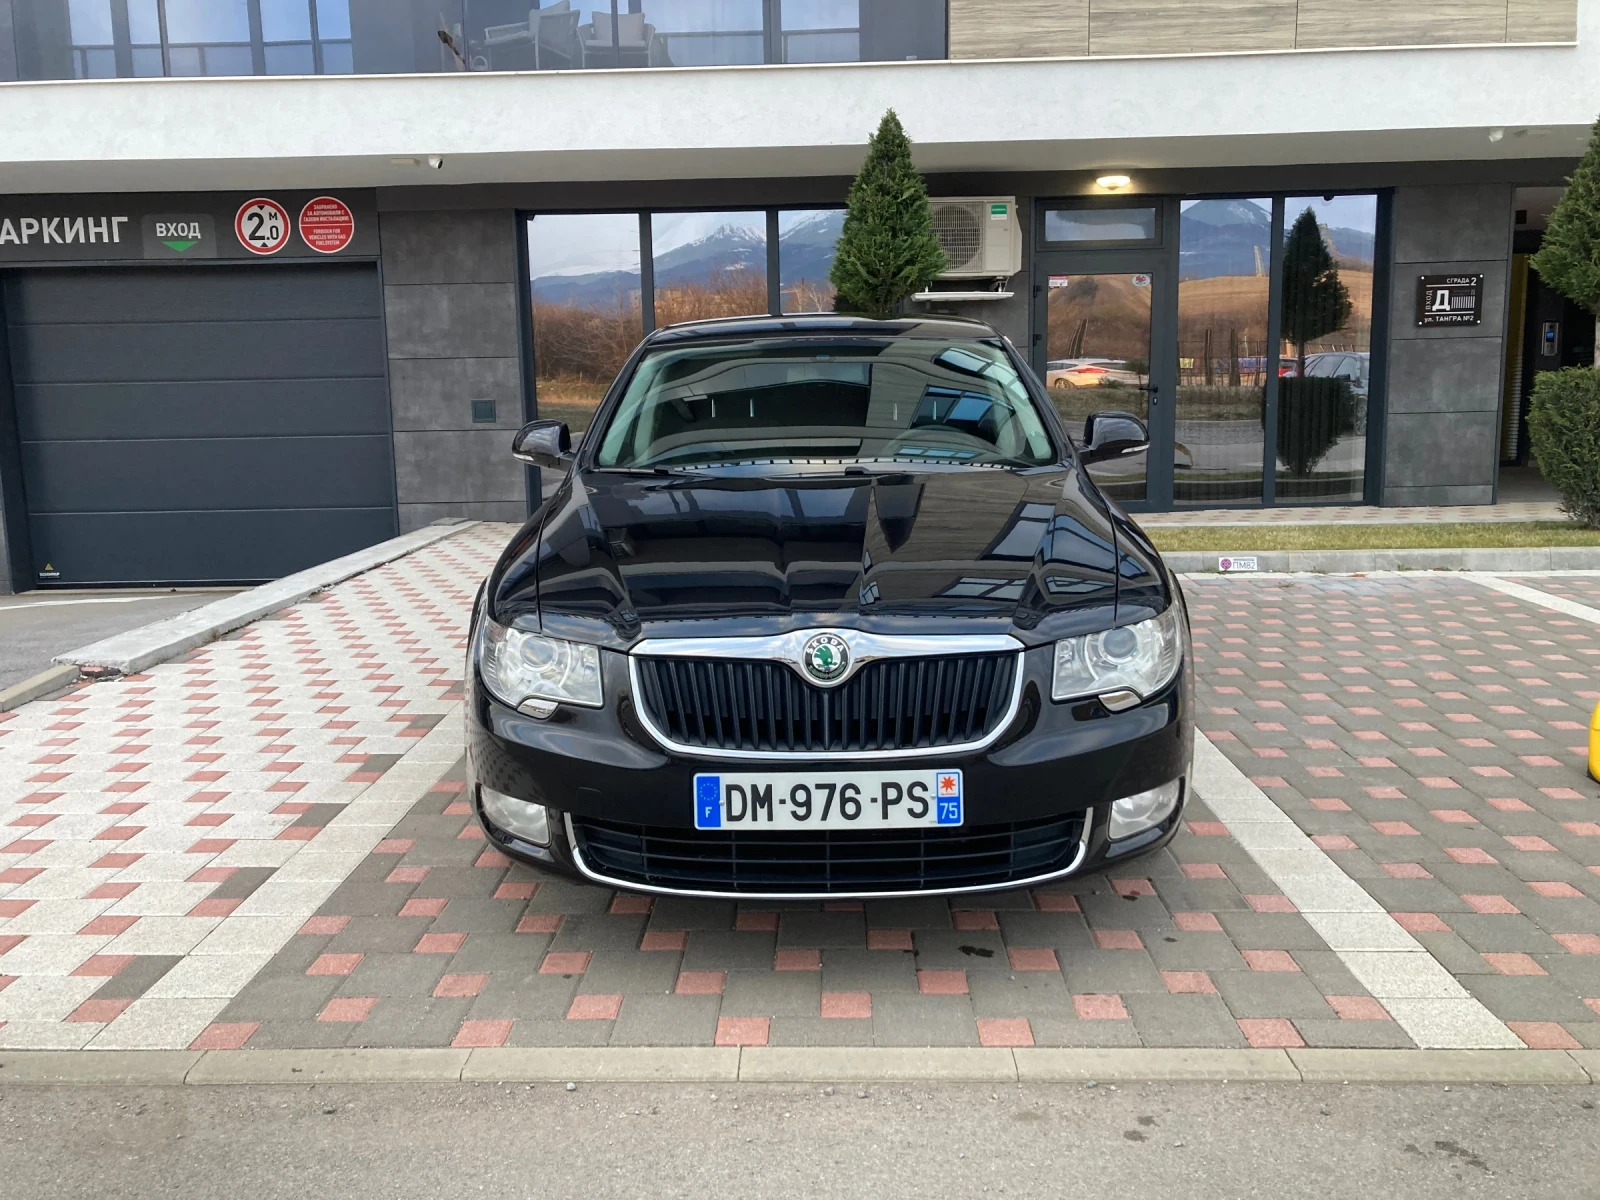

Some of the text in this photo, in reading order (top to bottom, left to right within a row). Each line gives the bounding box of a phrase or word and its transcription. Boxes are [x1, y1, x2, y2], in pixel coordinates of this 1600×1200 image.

[0, 216, 128, 245] АРКИНГ
[155, 222, 201, 239] ВХОД
[1470, 277, 1477, 286] 2
[1432, 290, 1450, 311] Д
[705, 780, 958, 822] F DM-976-PS 75
